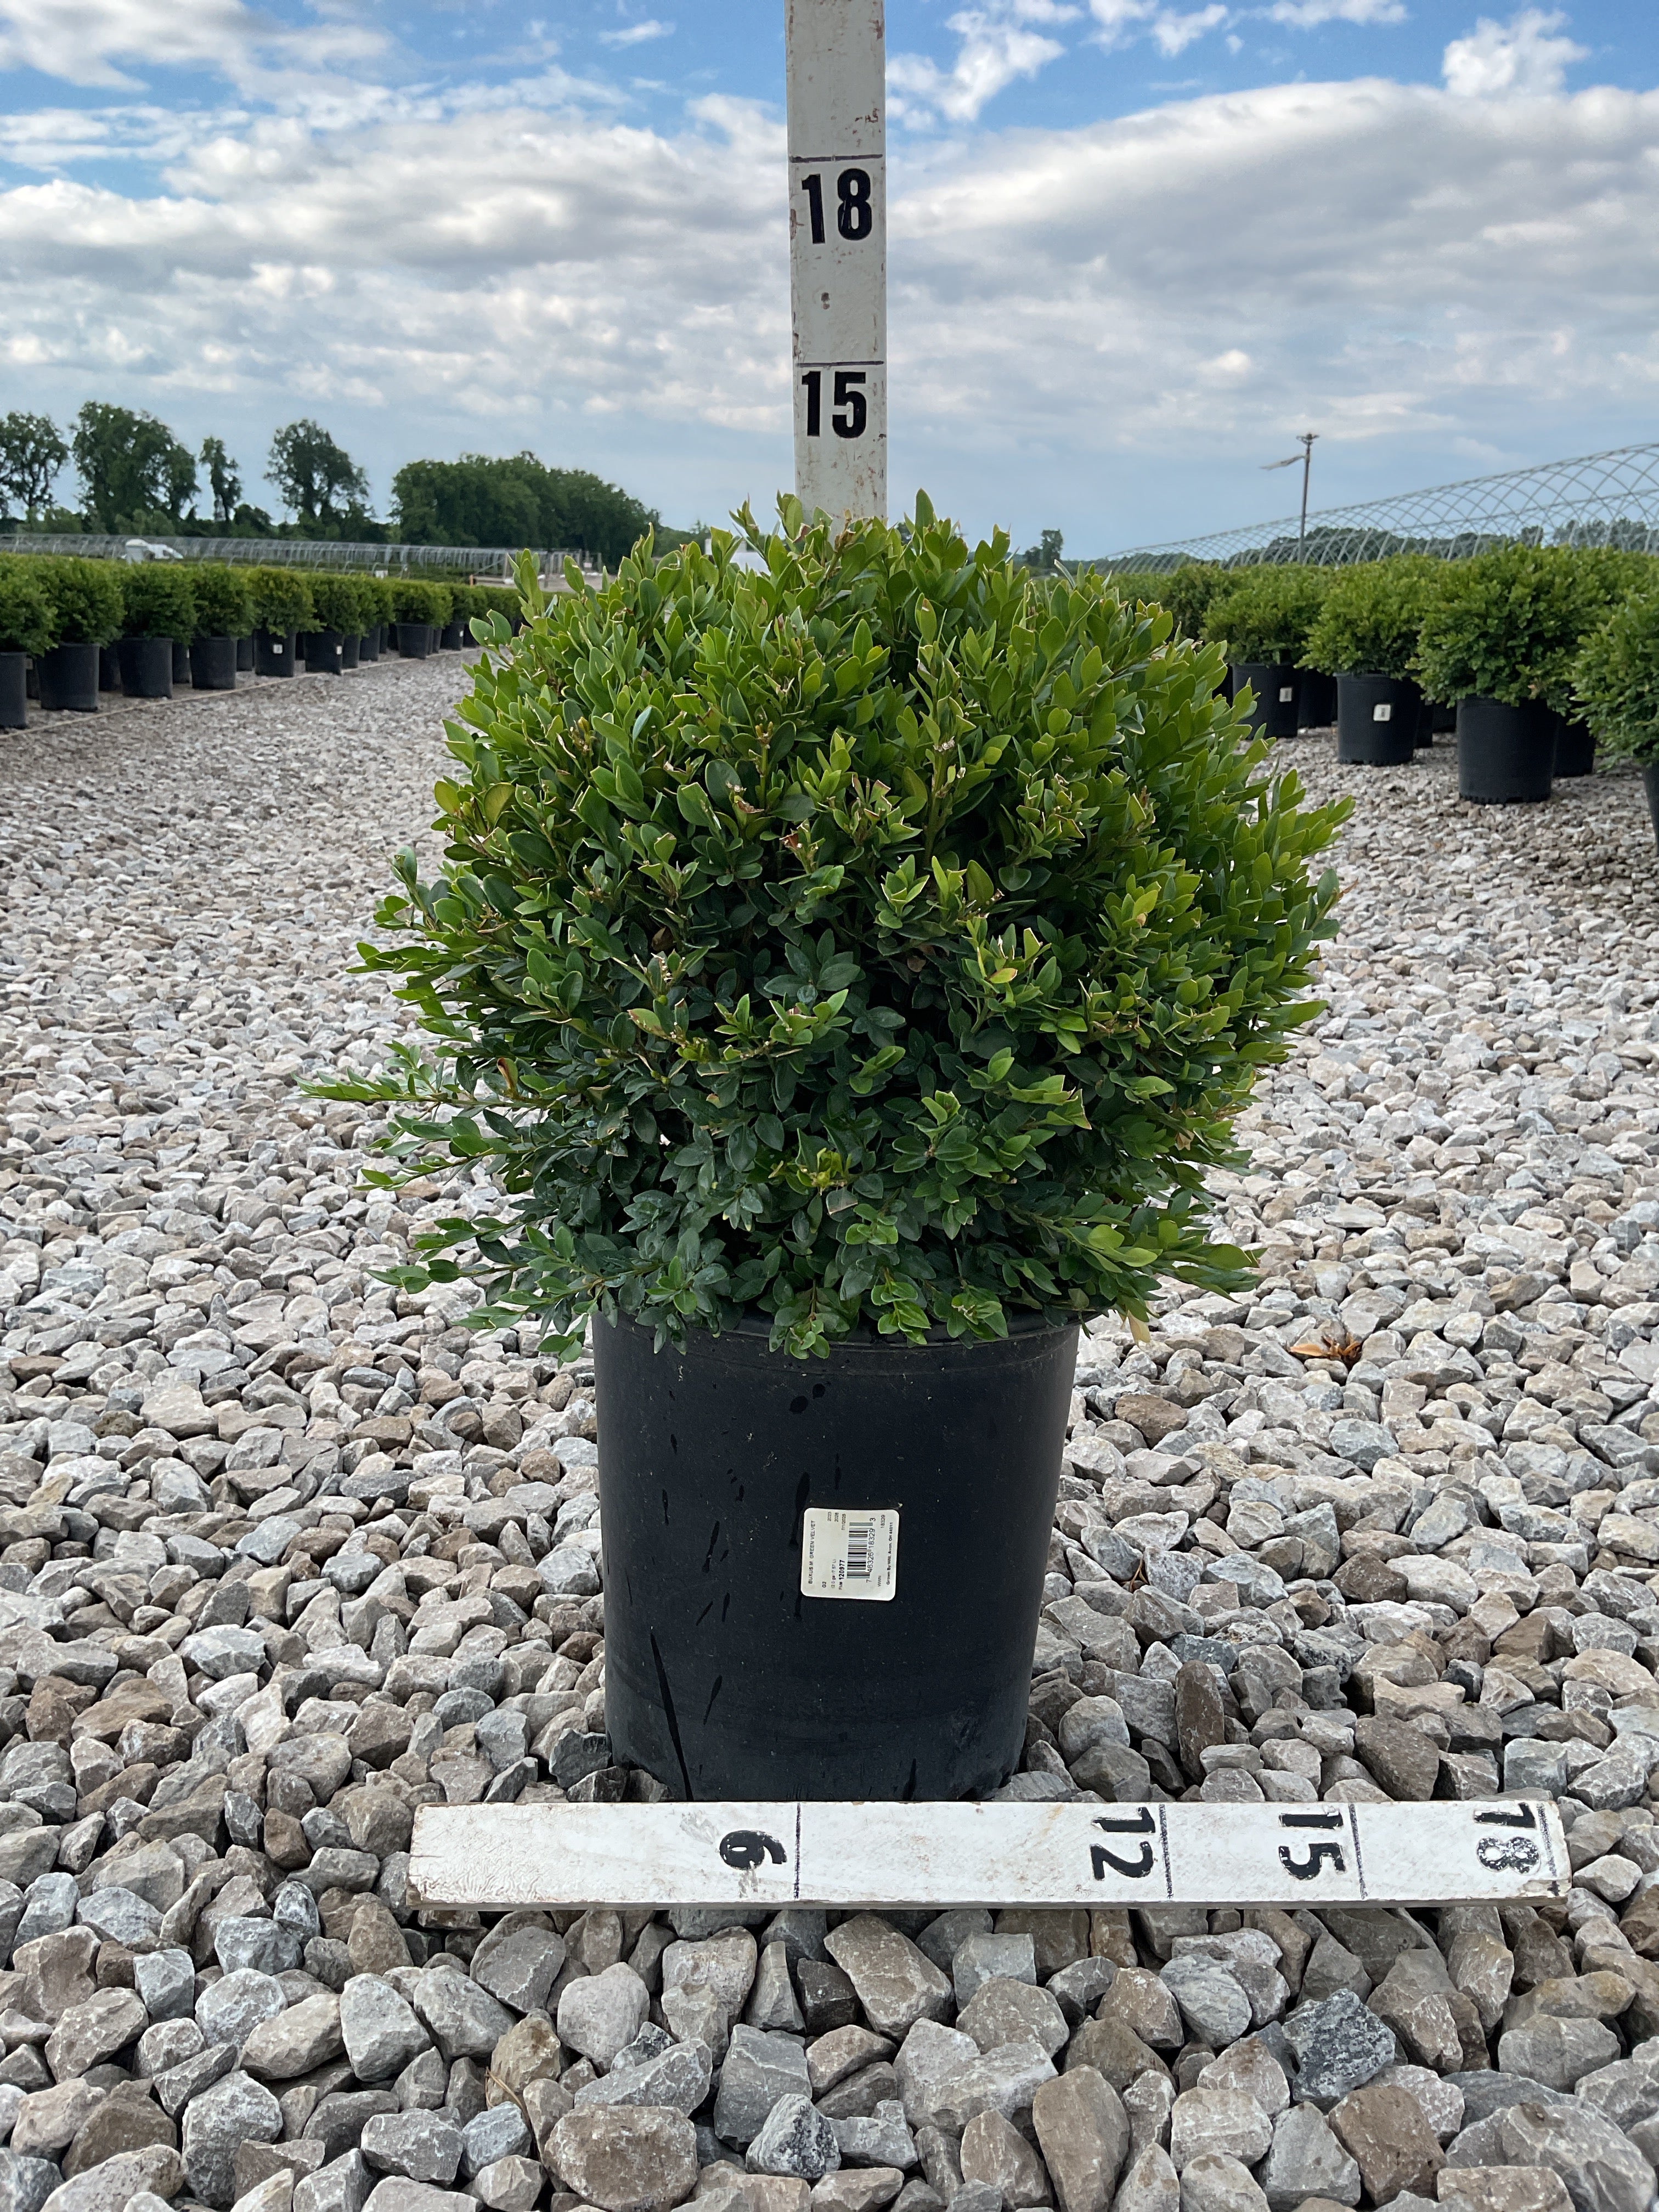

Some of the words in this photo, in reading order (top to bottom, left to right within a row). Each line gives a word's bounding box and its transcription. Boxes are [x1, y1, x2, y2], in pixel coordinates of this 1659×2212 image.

[801, 168, 872, 245] 18
[801, 371, 867, 439] 15
[719, 1830, 787, 1871] 6
[1090, 1807, 1156, 1881] 12
[1278, 1807, 1346, 1881] 15
[1472, 1802, 1542, 1875] 18
